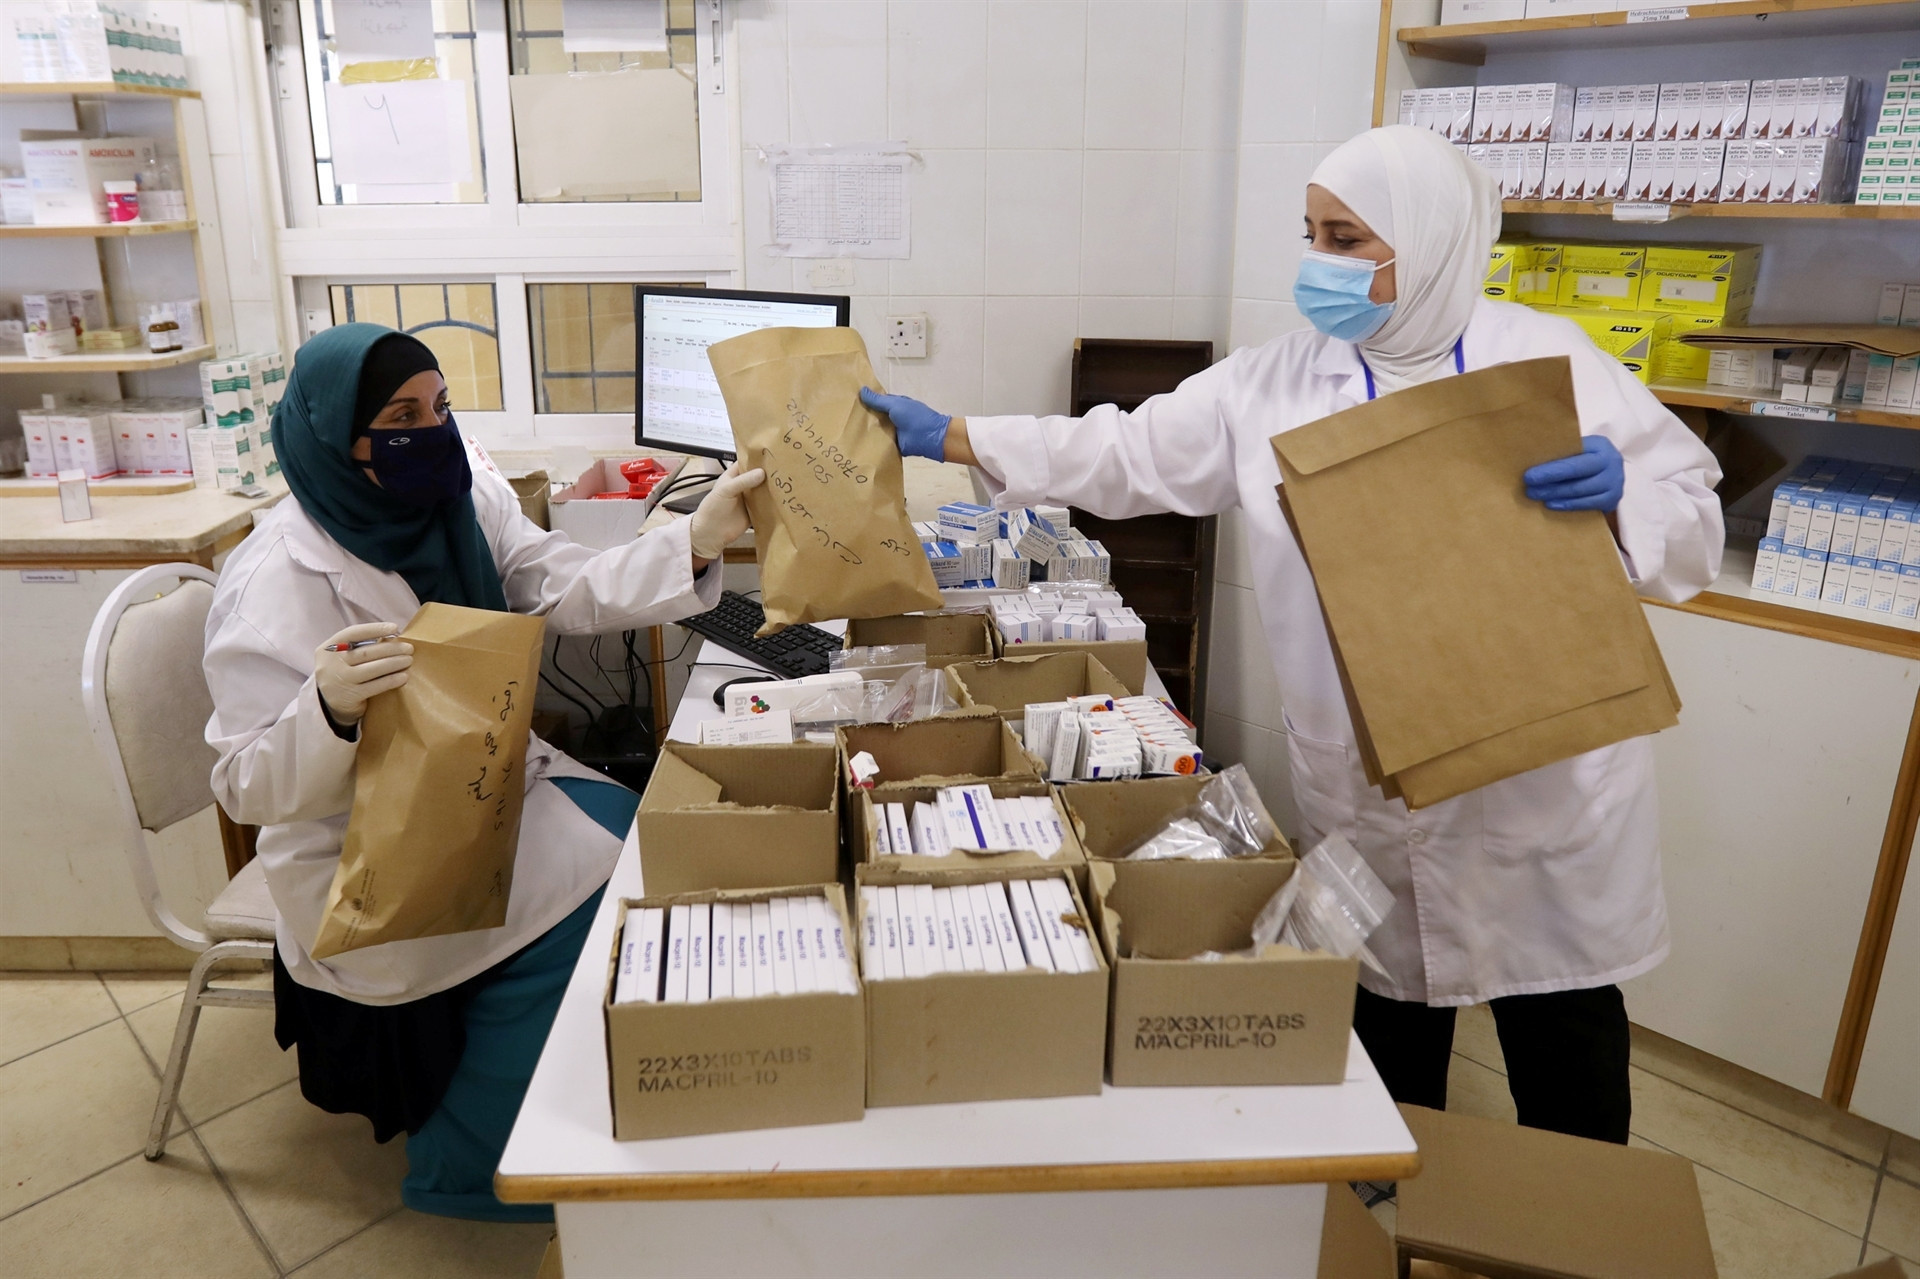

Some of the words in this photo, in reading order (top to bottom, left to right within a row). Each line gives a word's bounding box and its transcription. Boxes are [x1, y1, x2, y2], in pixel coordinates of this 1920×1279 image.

[89, 148, 134, 158] AMOXICILLIN
[1656, 271, 1698, 279] OCUCYCLINE
[1135, 1032, 1277, 1050] MACPRIL-10
[638, 1070, 778, 1093] MACPRIL-10
